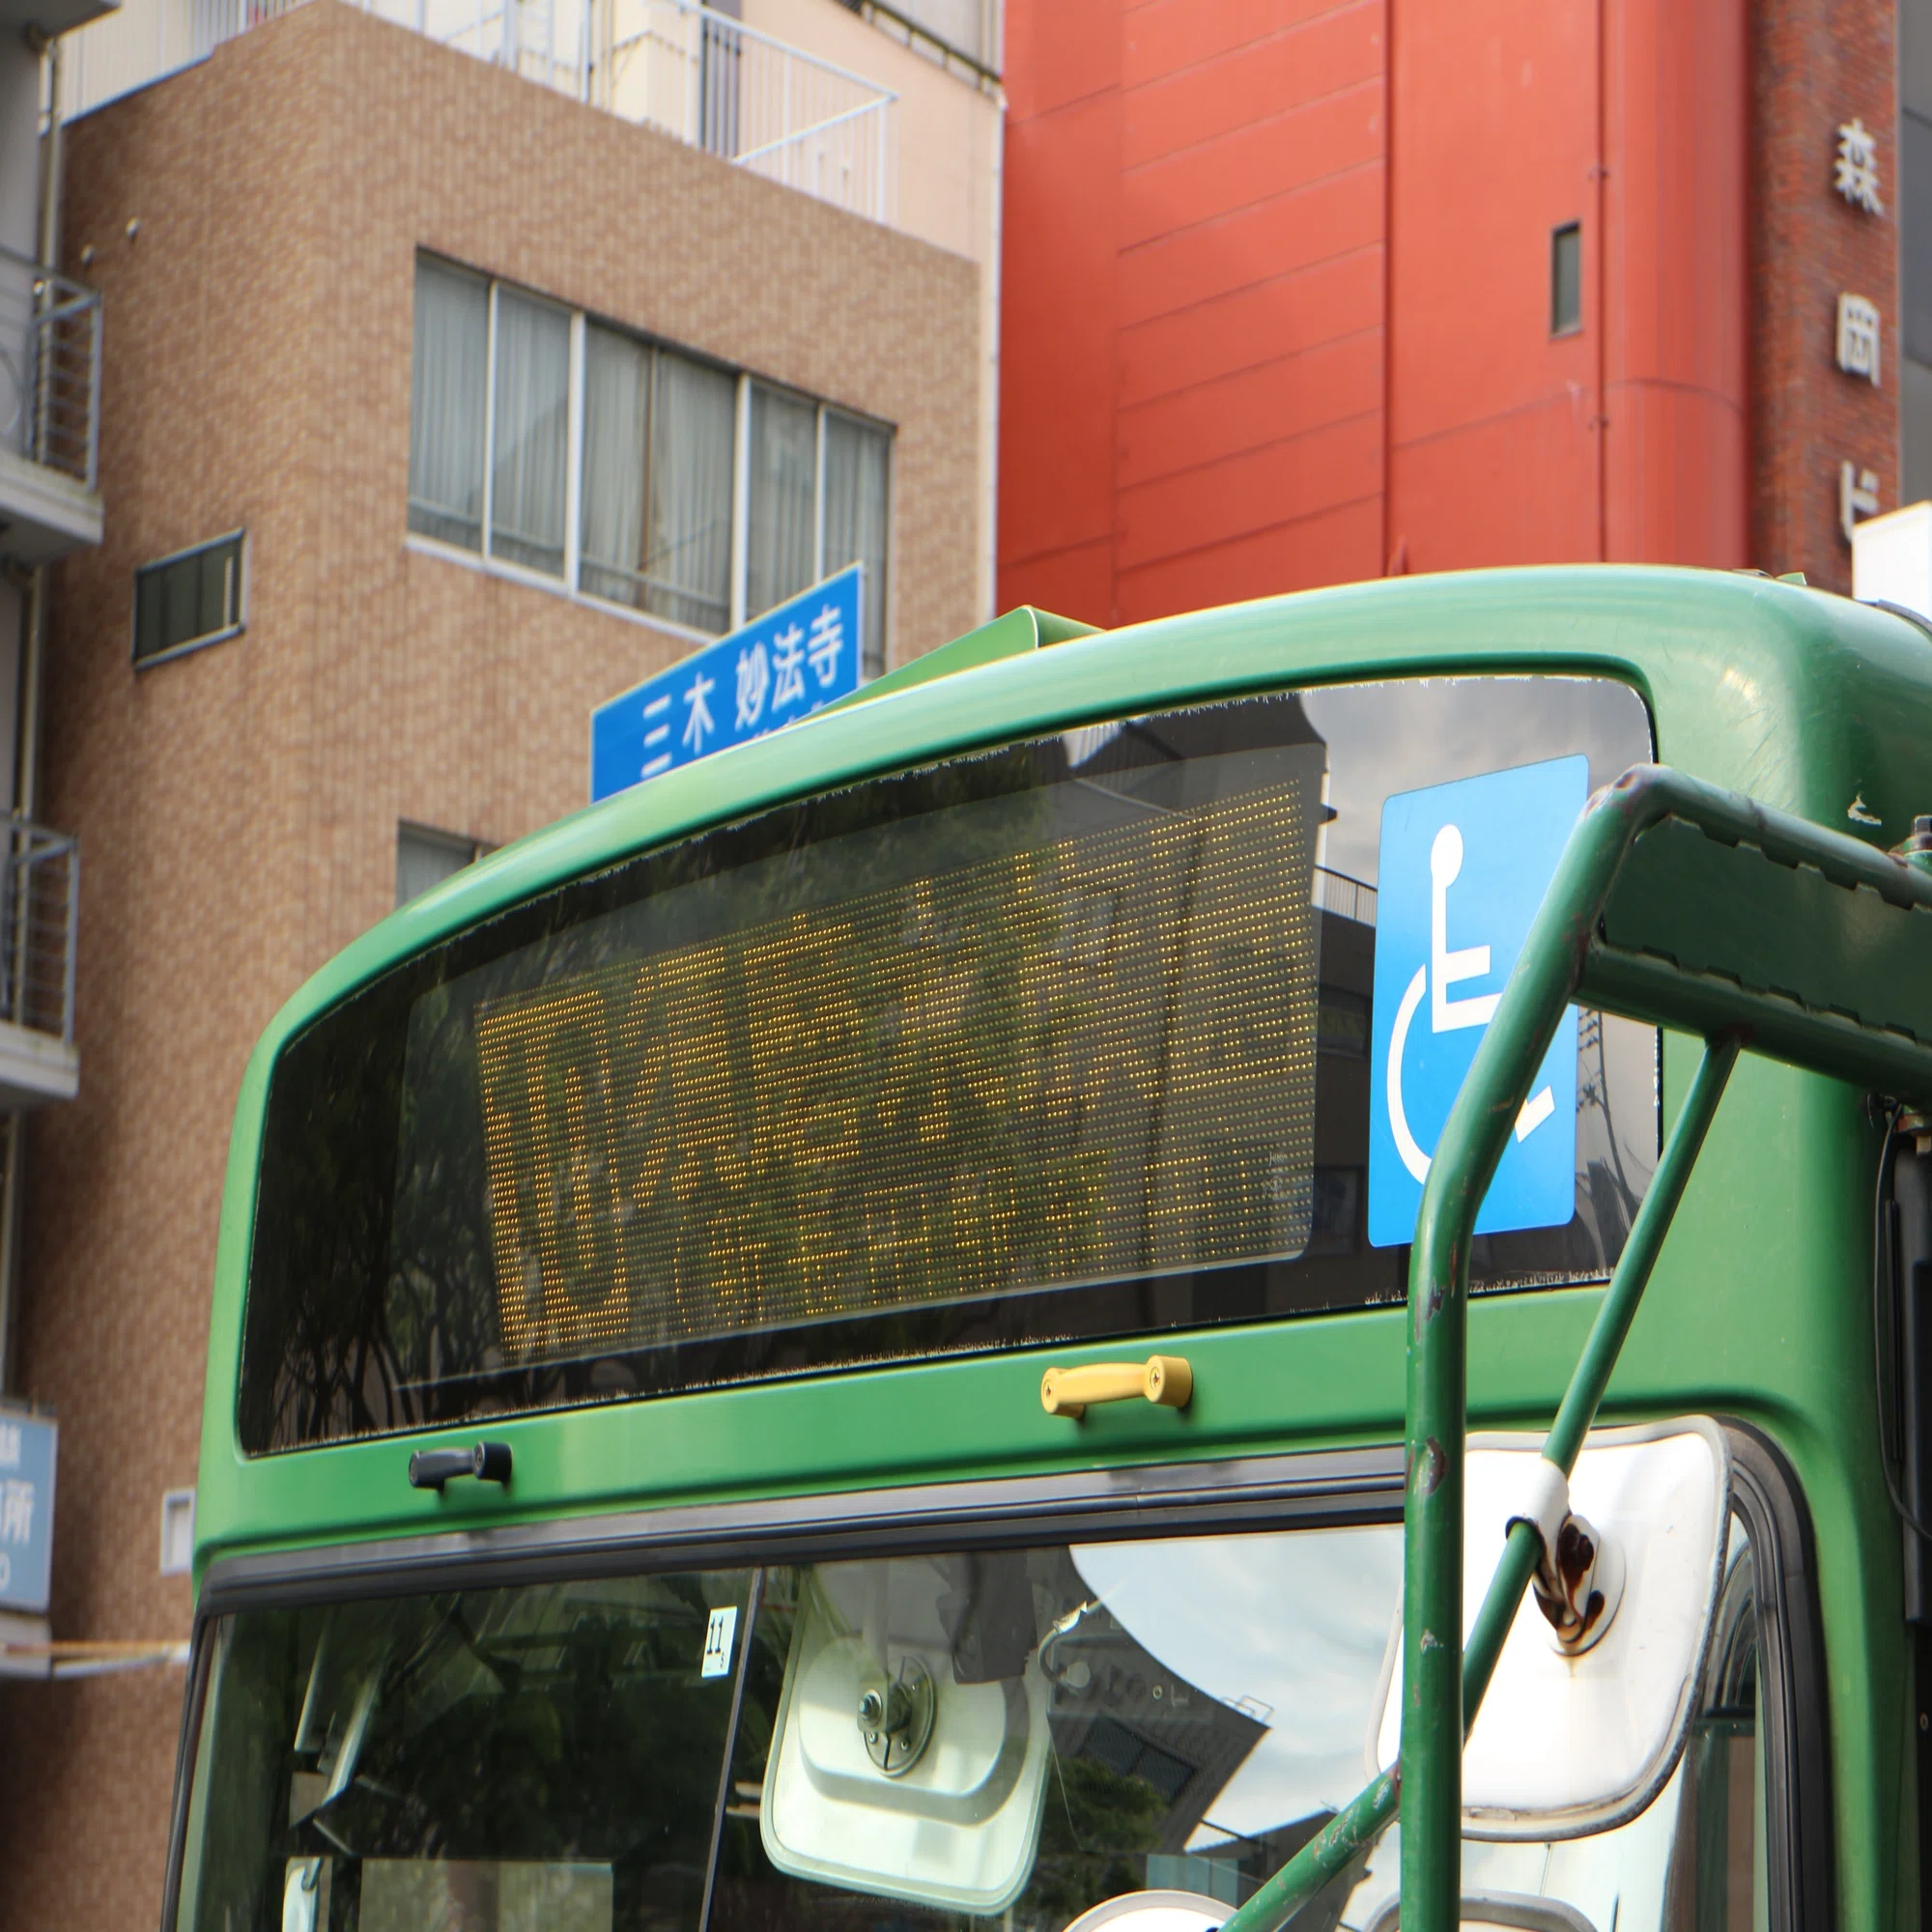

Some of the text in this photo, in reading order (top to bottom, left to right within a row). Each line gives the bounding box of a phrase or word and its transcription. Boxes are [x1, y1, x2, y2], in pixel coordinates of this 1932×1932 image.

[640, 603, 843, 780] 三木 妙法寺
[619, 794, 1315, 1209] 須磨水族園
[481, 1003, 626, 1341] 10
[706, 1615, 724, 1655] 11
